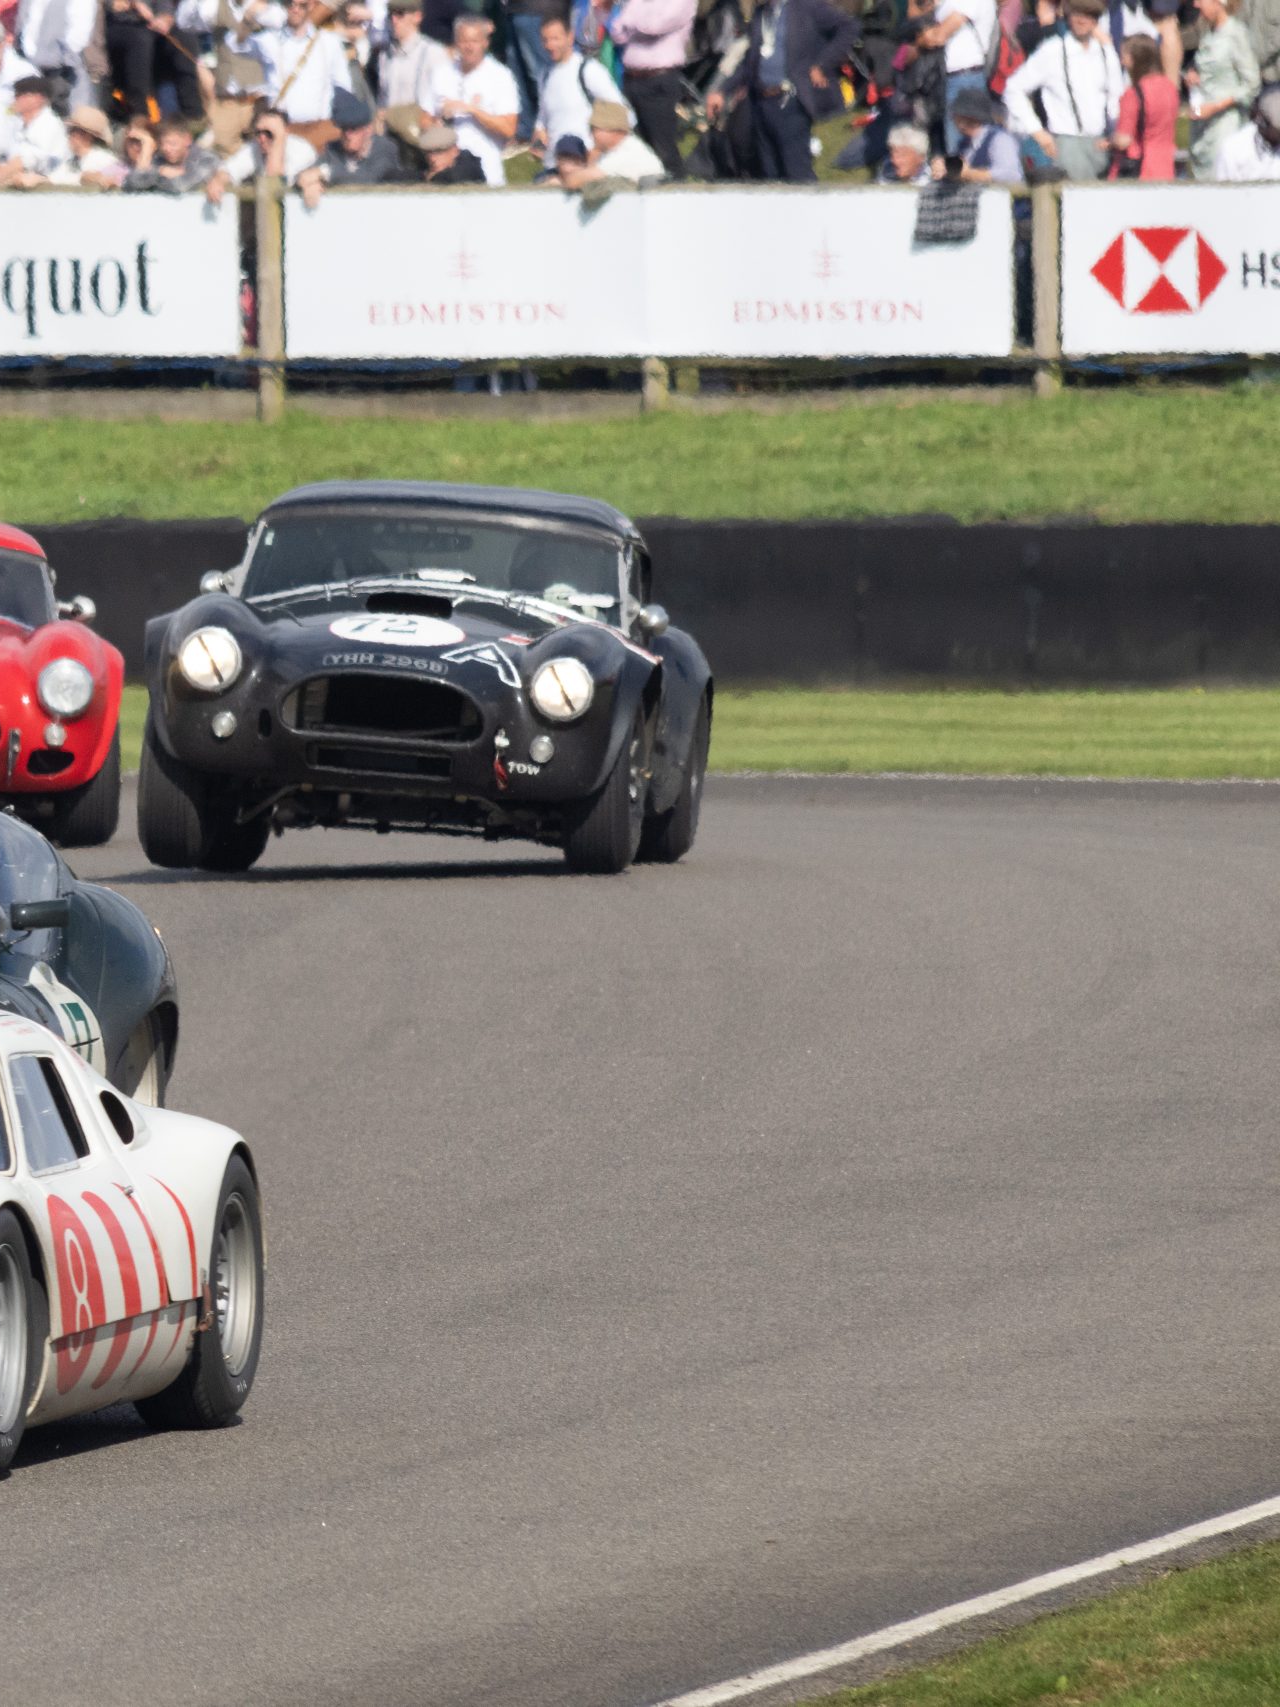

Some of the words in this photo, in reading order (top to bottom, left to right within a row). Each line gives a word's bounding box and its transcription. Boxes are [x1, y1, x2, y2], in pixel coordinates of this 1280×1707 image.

[369, 302, 568, 325] EDMISTON
[733, 300, 924, 323] EDMISTON
[508, 761, 540, 776] TOW
